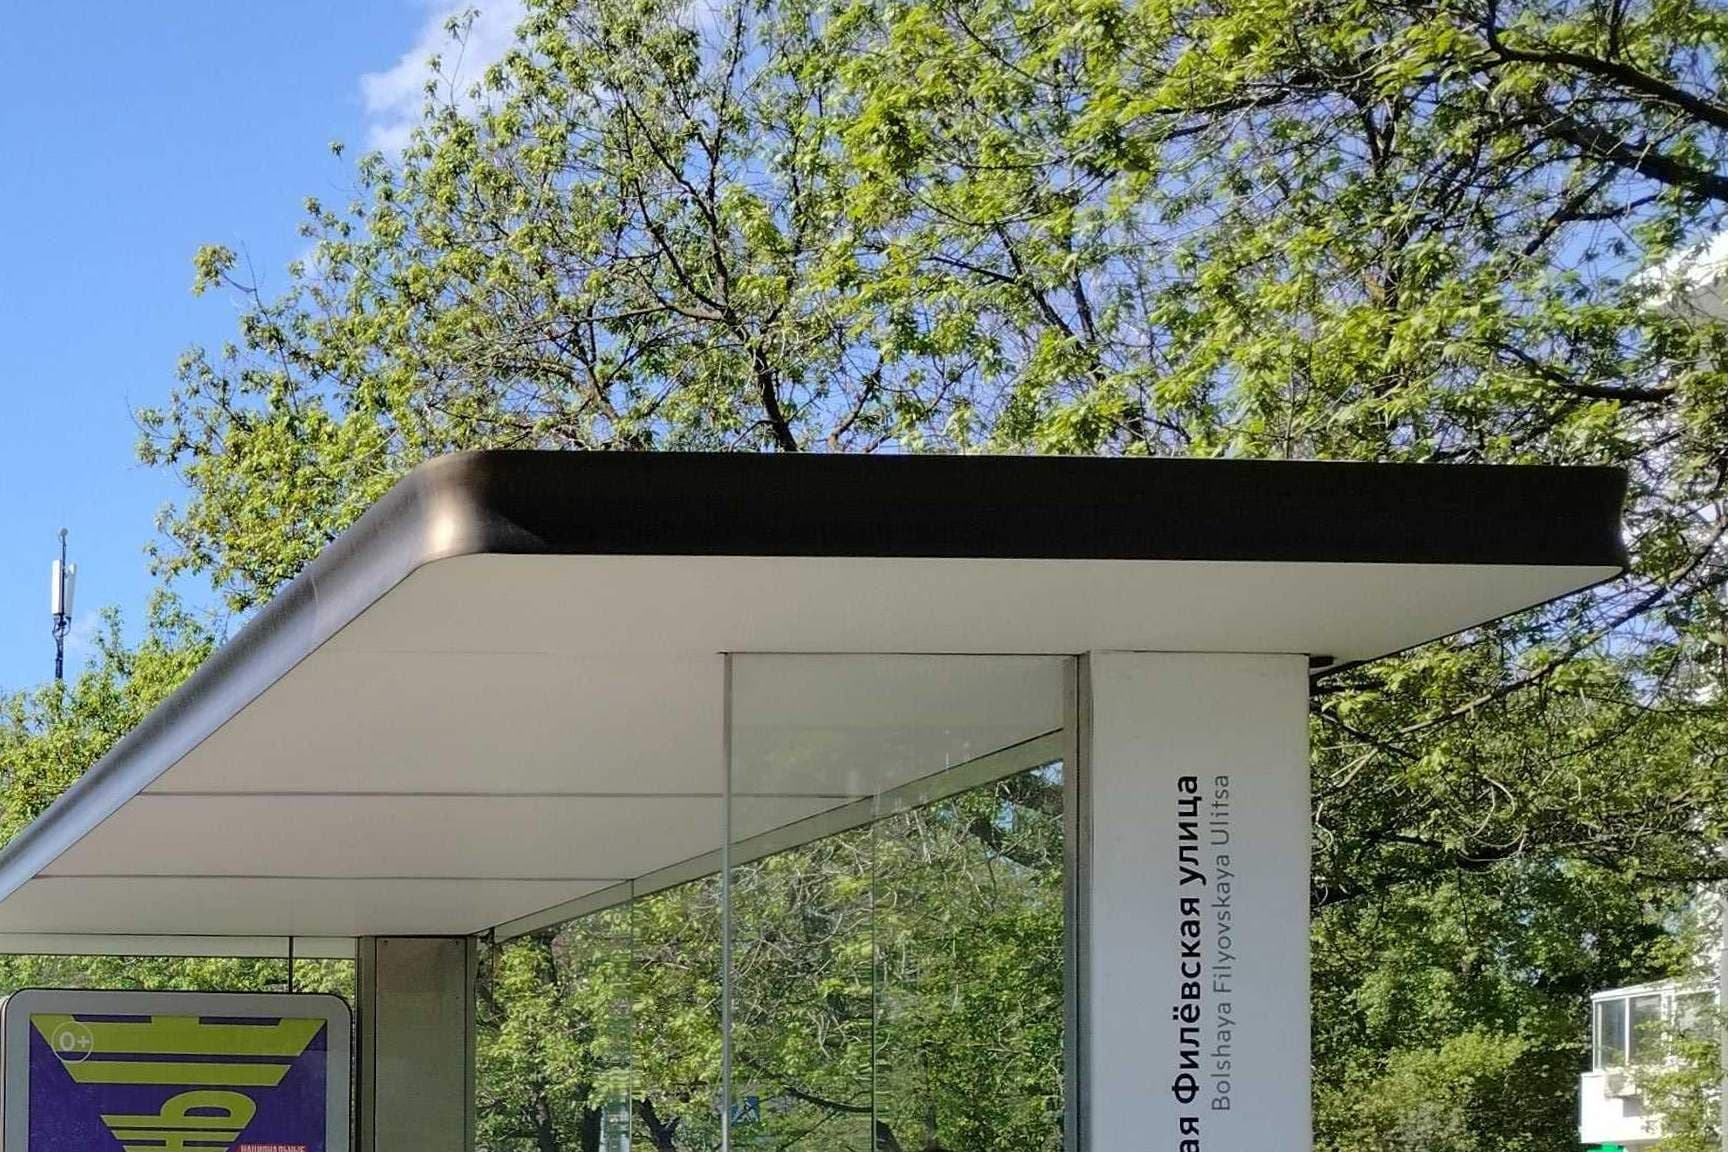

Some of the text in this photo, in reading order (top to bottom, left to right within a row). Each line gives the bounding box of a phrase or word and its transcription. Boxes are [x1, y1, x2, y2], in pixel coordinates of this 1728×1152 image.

[1177, 775, 1207, 886] улица
[1172, 897, 1201, 1104] Филёвская
[1209, 775, 1236, 1111] Bolshaya Filyovskaya Ulitsa
[58, 1031, 90, 1052] 0+
